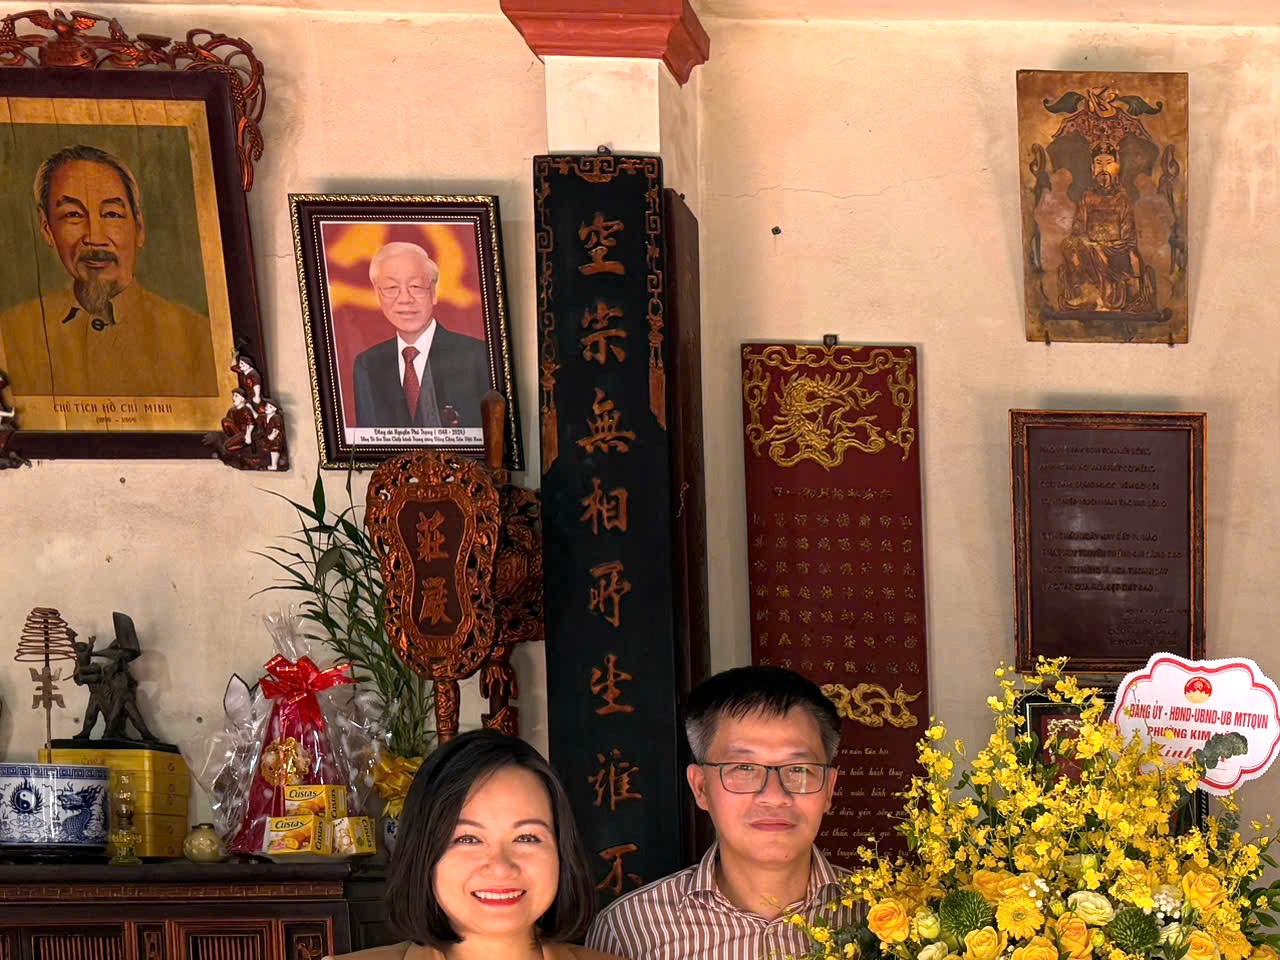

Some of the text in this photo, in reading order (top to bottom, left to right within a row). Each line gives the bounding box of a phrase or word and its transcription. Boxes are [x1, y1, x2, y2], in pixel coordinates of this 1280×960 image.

[102, 399, 116, 413] HỒ
[144, 404, 172, 414] MINH
[1234, 712, 1269, 730] MTTQVN
[1190, 729, 1212, 741] KIM
[289, 788, 317, 798] Custas
[274, 820, 304, 830] Custas
